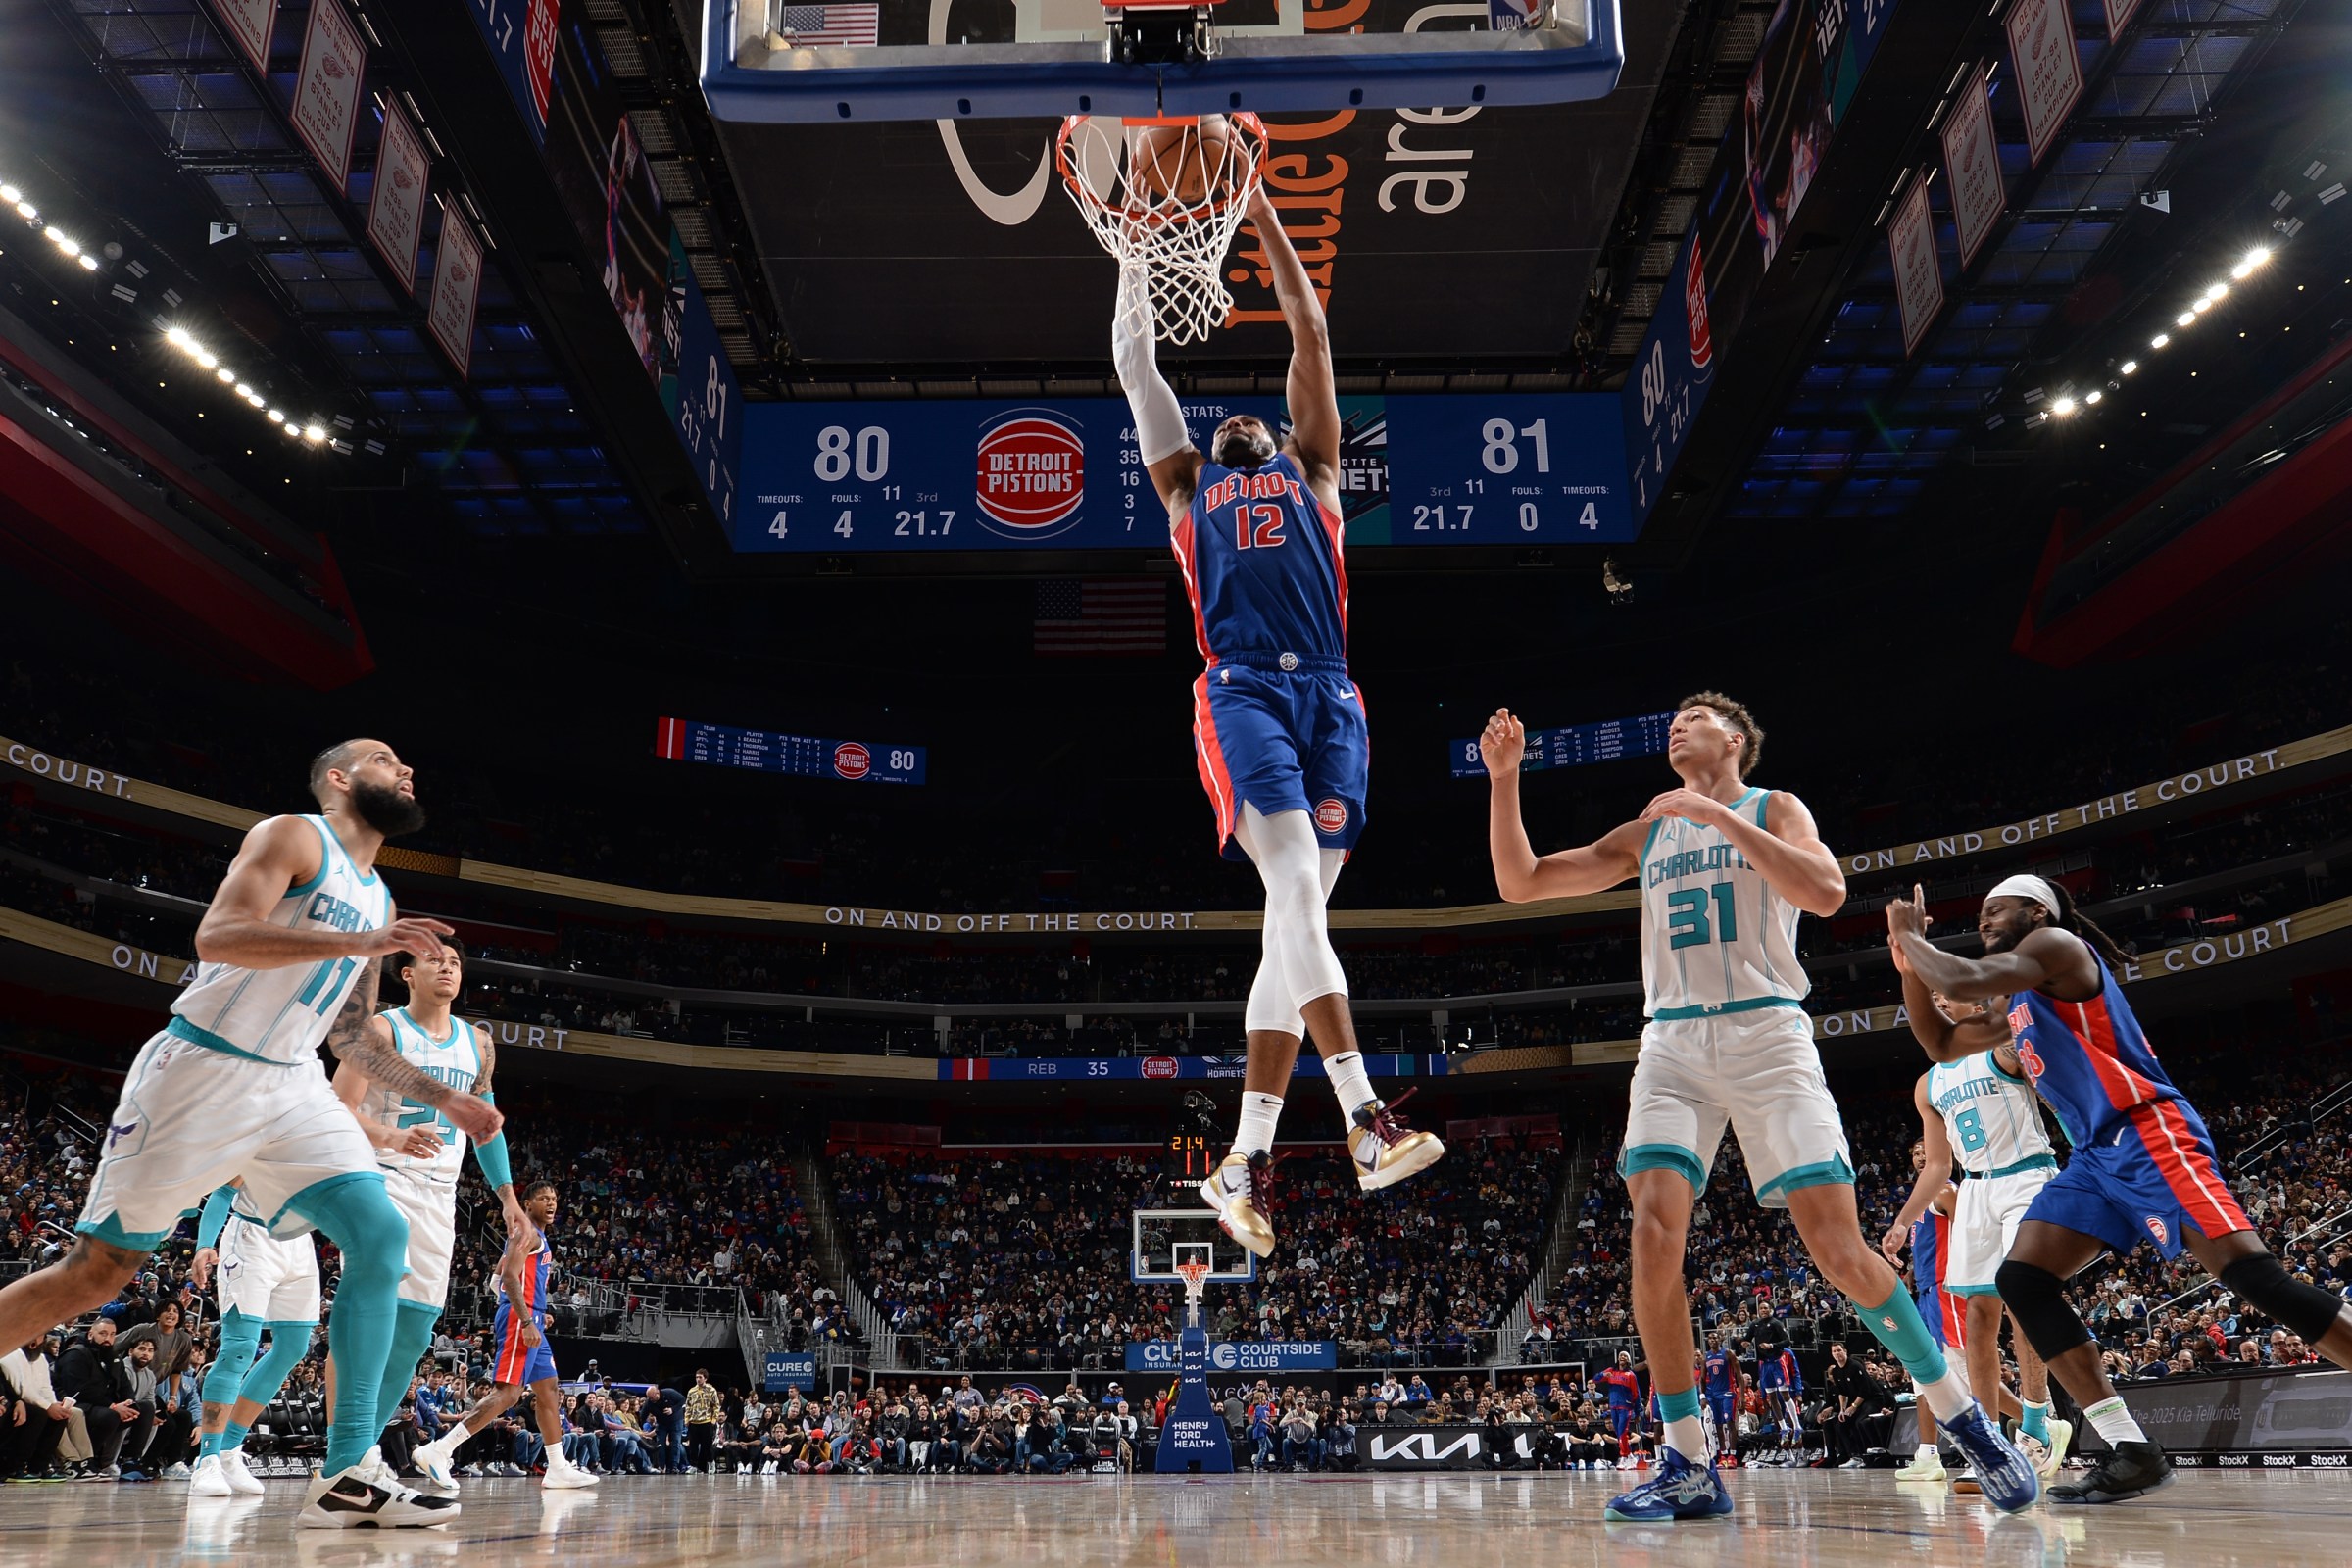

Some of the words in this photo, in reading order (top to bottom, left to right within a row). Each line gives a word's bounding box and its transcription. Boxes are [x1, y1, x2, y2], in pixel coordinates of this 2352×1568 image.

[325, 7, 354, 56] DETROIT
[1496, 14, 1521, 31] NBA
[2017, 22, 2032, 48] RED
[318, 13, 332, 39] RED
[333, 41, 355, 77] WINGS
[2034, 51, 2062, 103] STANLEY
[2043, 78, 2058, 105] CUP
[310, 82, 341, 132] STANLEY
[1952, 94, 1978, 140] DETROIT
[2034, 74, 2074, 139] CHAMPIONS
[317, 109, 331, 133] CUP
[1952, 139, 1963, 160] RED
[1963, 102, 1984, 137] WINGS
[301, 105, 341, 168] CHAMPIONS
[1964, 167, 1989, 213] STANLEY
[383, 196, 410, 238] STANLEY
[1897, 197, 1919, 237] DETROIT
[1965, 189, 1997, 245] CHAMPIONS
[1973, 193, 1984, 216] CUP
[388, 221, 402, 240] CUP
[1907, 204, 1925, 236] WINGS
[375, 218, 410, 270] CHAMPIONS
[1908, 268, 1930, 306] STANLEY
[1642, 339, 1665, 427] 80
[706, 354, 727, 441] 81
[1182, 406, 1229, 418] STATS:
[1670, 384, 1689, 444] 21.7
[681, 399, 701, 454] 21.7
[1119, 427, 1140, 442] 44
[814, 425, 890, 482] 80
[1119, 449, 1140, 465] 35
[1482, 417, 1550, 474] 81
[1655, 443, 1662, 474] 4
[709, 458, 716, 492] 0
[988, 453, 1072, 472] DETROIT
[987, 473, 1073, 493] PISTONS
[1119, 471, 1140, 487] 16
[1429, 486, 1451, 497] 3rd
[1465, 479, 1484, 494] 11
[1512, 486, 1543, 495] FOULS:
[1562, 486, 1610, 495] TIMEOUTS:
[723, 491, 730, 521] 4
[757, 495, 804, 504] TIMEOUTS:
[831, 494, 862, 503] FOULS:
[882, 485, 901, 501] 11
[916, 492, 938, 503] 3rd
[1124, 494, 1135, 509] 3
[1640, 477, 1646, 509] 4
[768, 511, 788, 539] 4
[833, 510, 854, 538] 4
[894, 510, 956, 536] 21.7
[1124, 516, 1135, 531] 7
[1235, 504, 1287, 551] 12
[1413, 505, 1474, 530] 21.7
[1519, 502, 1539, 531] 0
[1579, 502, 1599, 530] 4
[838, 760, 866, 769] PISTONS
[839, 753, 866, 761] DETROIT
[889, 750, 915, 771] 80
[8, 744, 132, 799] COURT.
[1851, 849, 1896, 874] ON
[1913, 832, 1984, 862] AND
[2001, 812, 2060, 845] OFF
[2076, 791, 2139, 825] THE
[2157, 749, 2286, 802] COURT.
[825, 906, 865, 926] ON
[881, 912, 942, 932] AND
[956, 914, 1010, 932] OFF
[1025, 912, 1080, 931] THE
[1096, 912, 1199, 931] COURT.
[1668, 881, 1738, 951] 31
[2164, 917, 2293, 972] COURT
[112, 945, 159, 978] ON
[299, 956, 357, 1017] 11
[472, 1019, 568, 1050] OURT
[1823, 1010, 1871, 1036] ON
[1028, 1063, 1057, 1075] REB
[1087, 1062, 1109, 1076] 35
[1172, 1136, 1203, 1150] 21.4
[1954, 1107, 1987, 1153] 8
[1186, 1150, 1210, 1175] 11
[1240, 1344, 1322, 1356] COURTSIDE
[1240, 1356, 1279, 1368] CLUB
[766, 1362, 802, 1373] CURE
[2133, 1408, 2149, 1424] The
[2151, 1407, 2175, 1424] 2025
[2177, 1406, 2193, 1423] Kia
[2195, 1405, 2243, 1422] Telluride.
[1174, 1430, 1201, 1439] FORD
[2175, 1455, 2203, 1466] StockX
[2218, 1455, 2249, 1467] StockX
[2262, 1454, 2296, 1467] StockX
[2310, 1454, 2348, 1467] StockX
